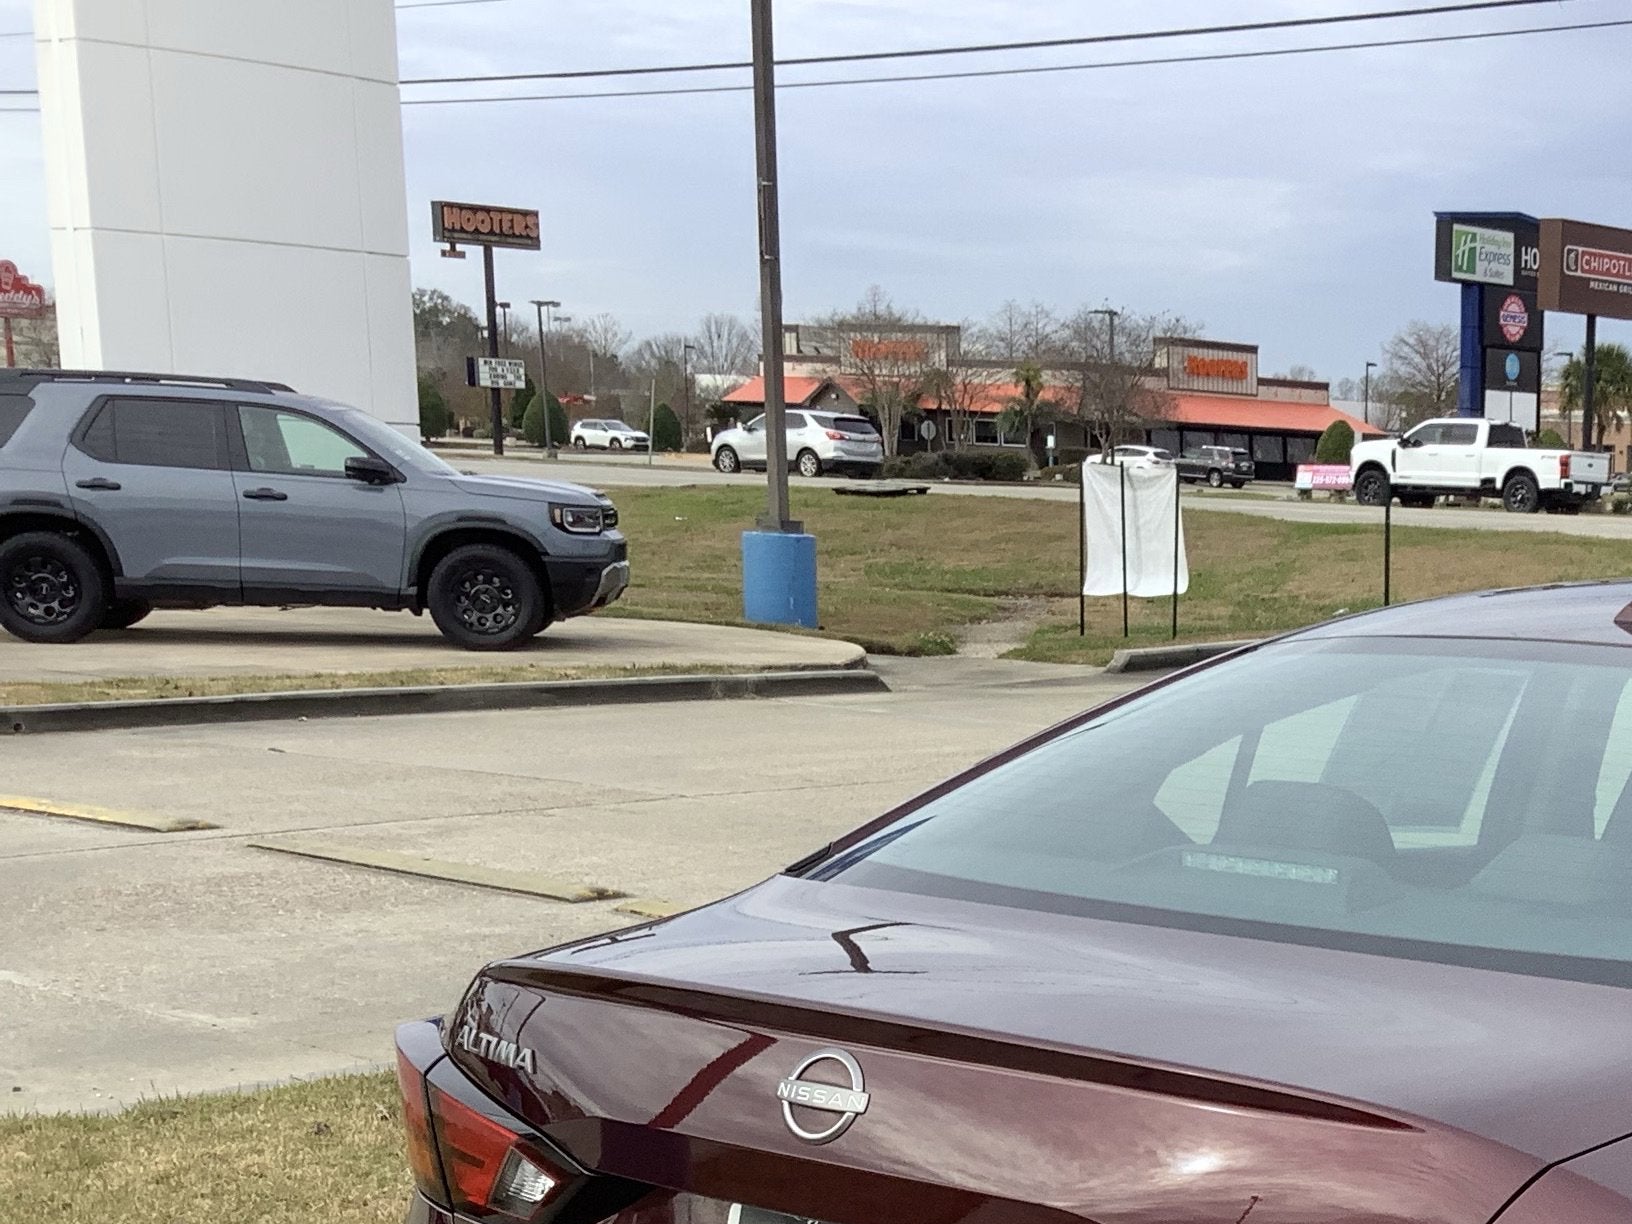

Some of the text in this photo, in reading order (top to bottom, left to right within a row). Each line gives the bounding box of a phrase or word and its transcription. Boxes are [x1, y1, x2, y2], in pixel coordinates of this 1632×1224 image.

[443, 205, 539, 238] HOOTERS
[1479, 246, 1511, 266] Express
[455, 1025, 533, 1074] ALTIMA
[777, 1082, 865, 1109] NISSAN
